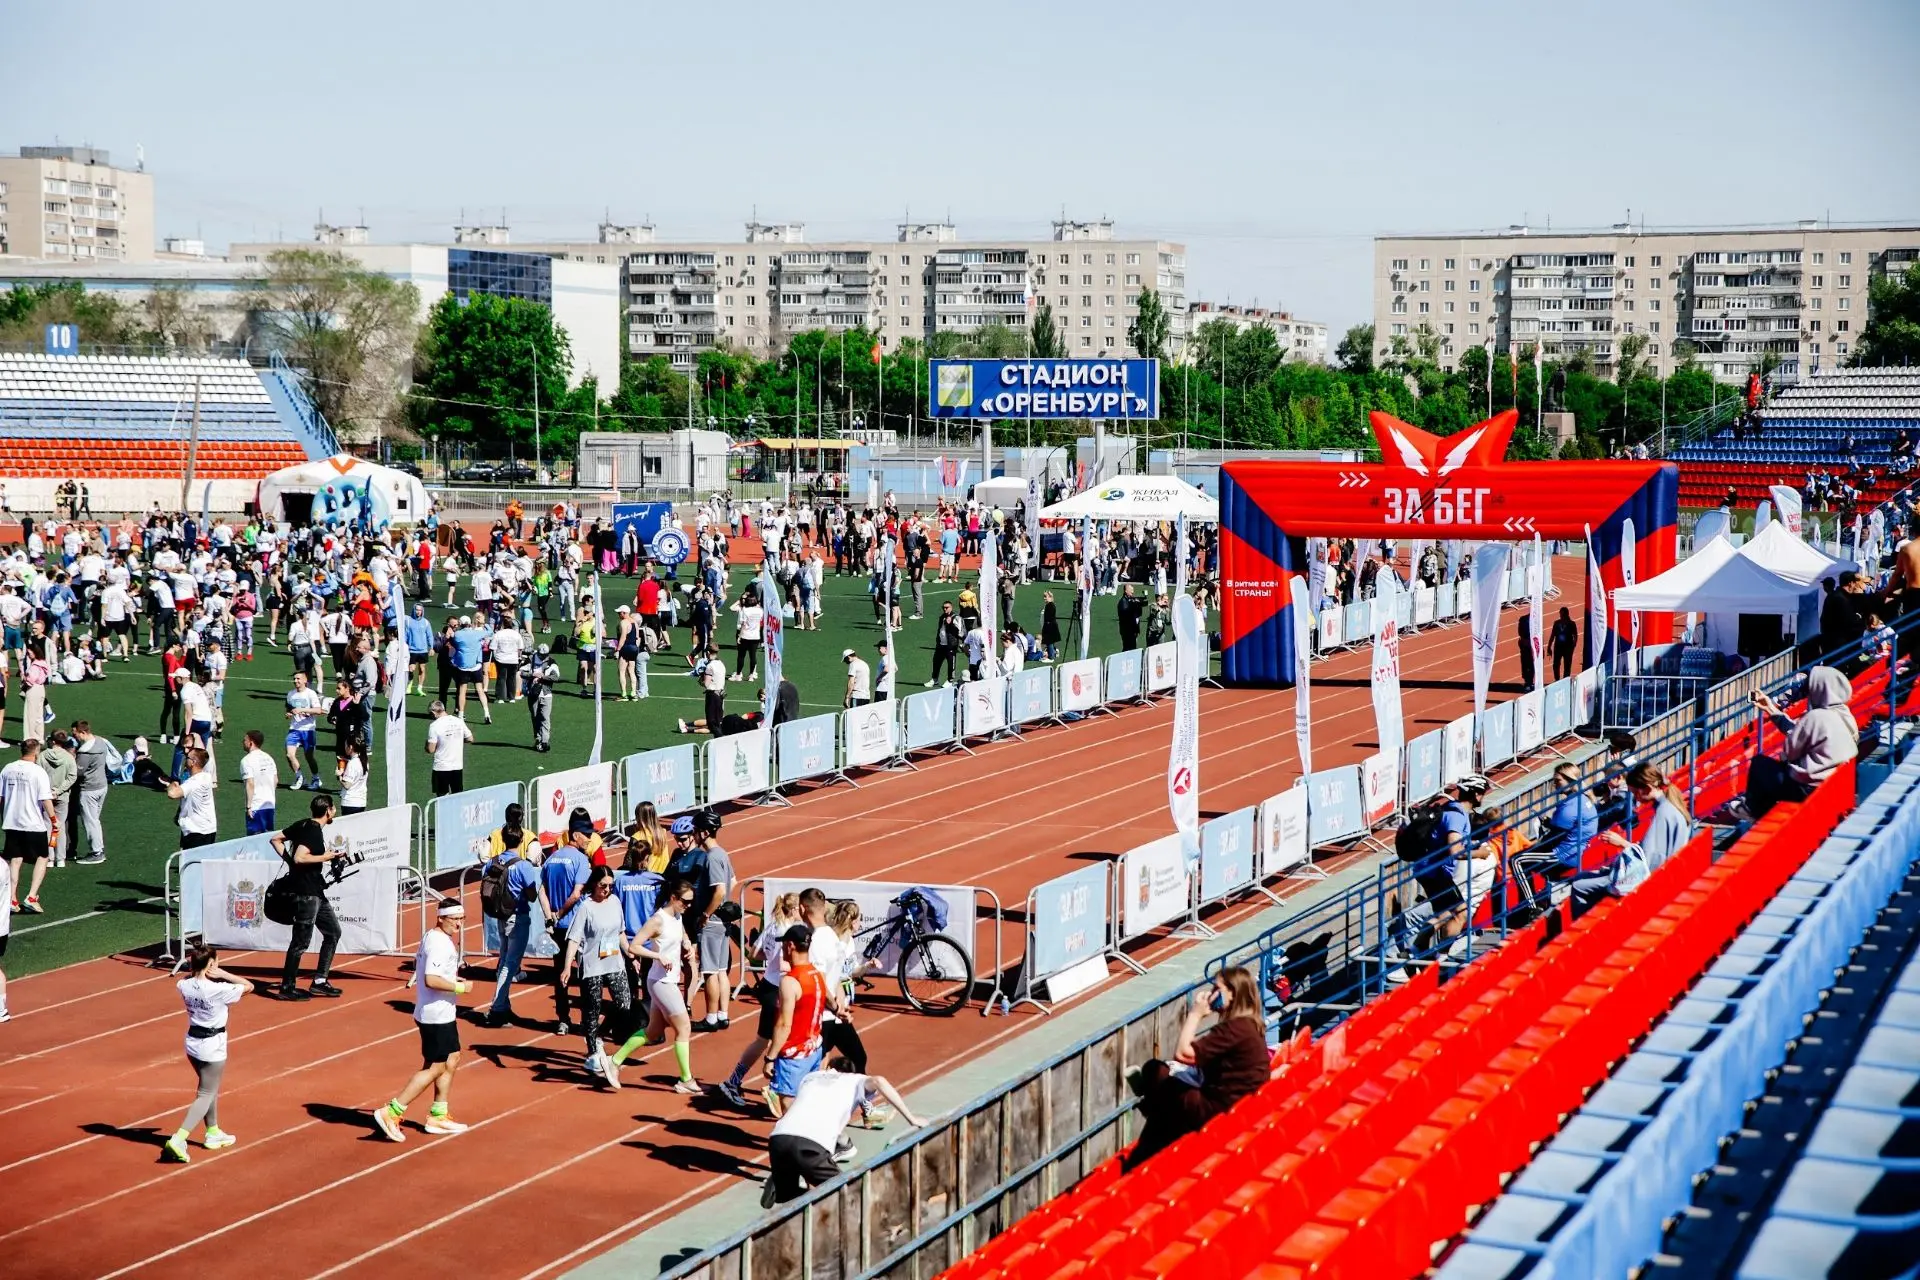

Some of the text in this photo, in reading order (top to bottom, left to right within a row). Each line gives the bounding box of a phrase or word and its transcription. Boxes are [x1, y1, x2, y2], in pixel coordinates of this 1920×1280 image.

[51, 325, 71, 349] 10
[1001, 364, 1127, 388] СТАДИОН
[981, 392, 1148, 413] «ОРЕНБУРГ»
[1234, 589, 1272, 597] СТРАНЫ!
[1235, 580, 1259, 588] ритме
